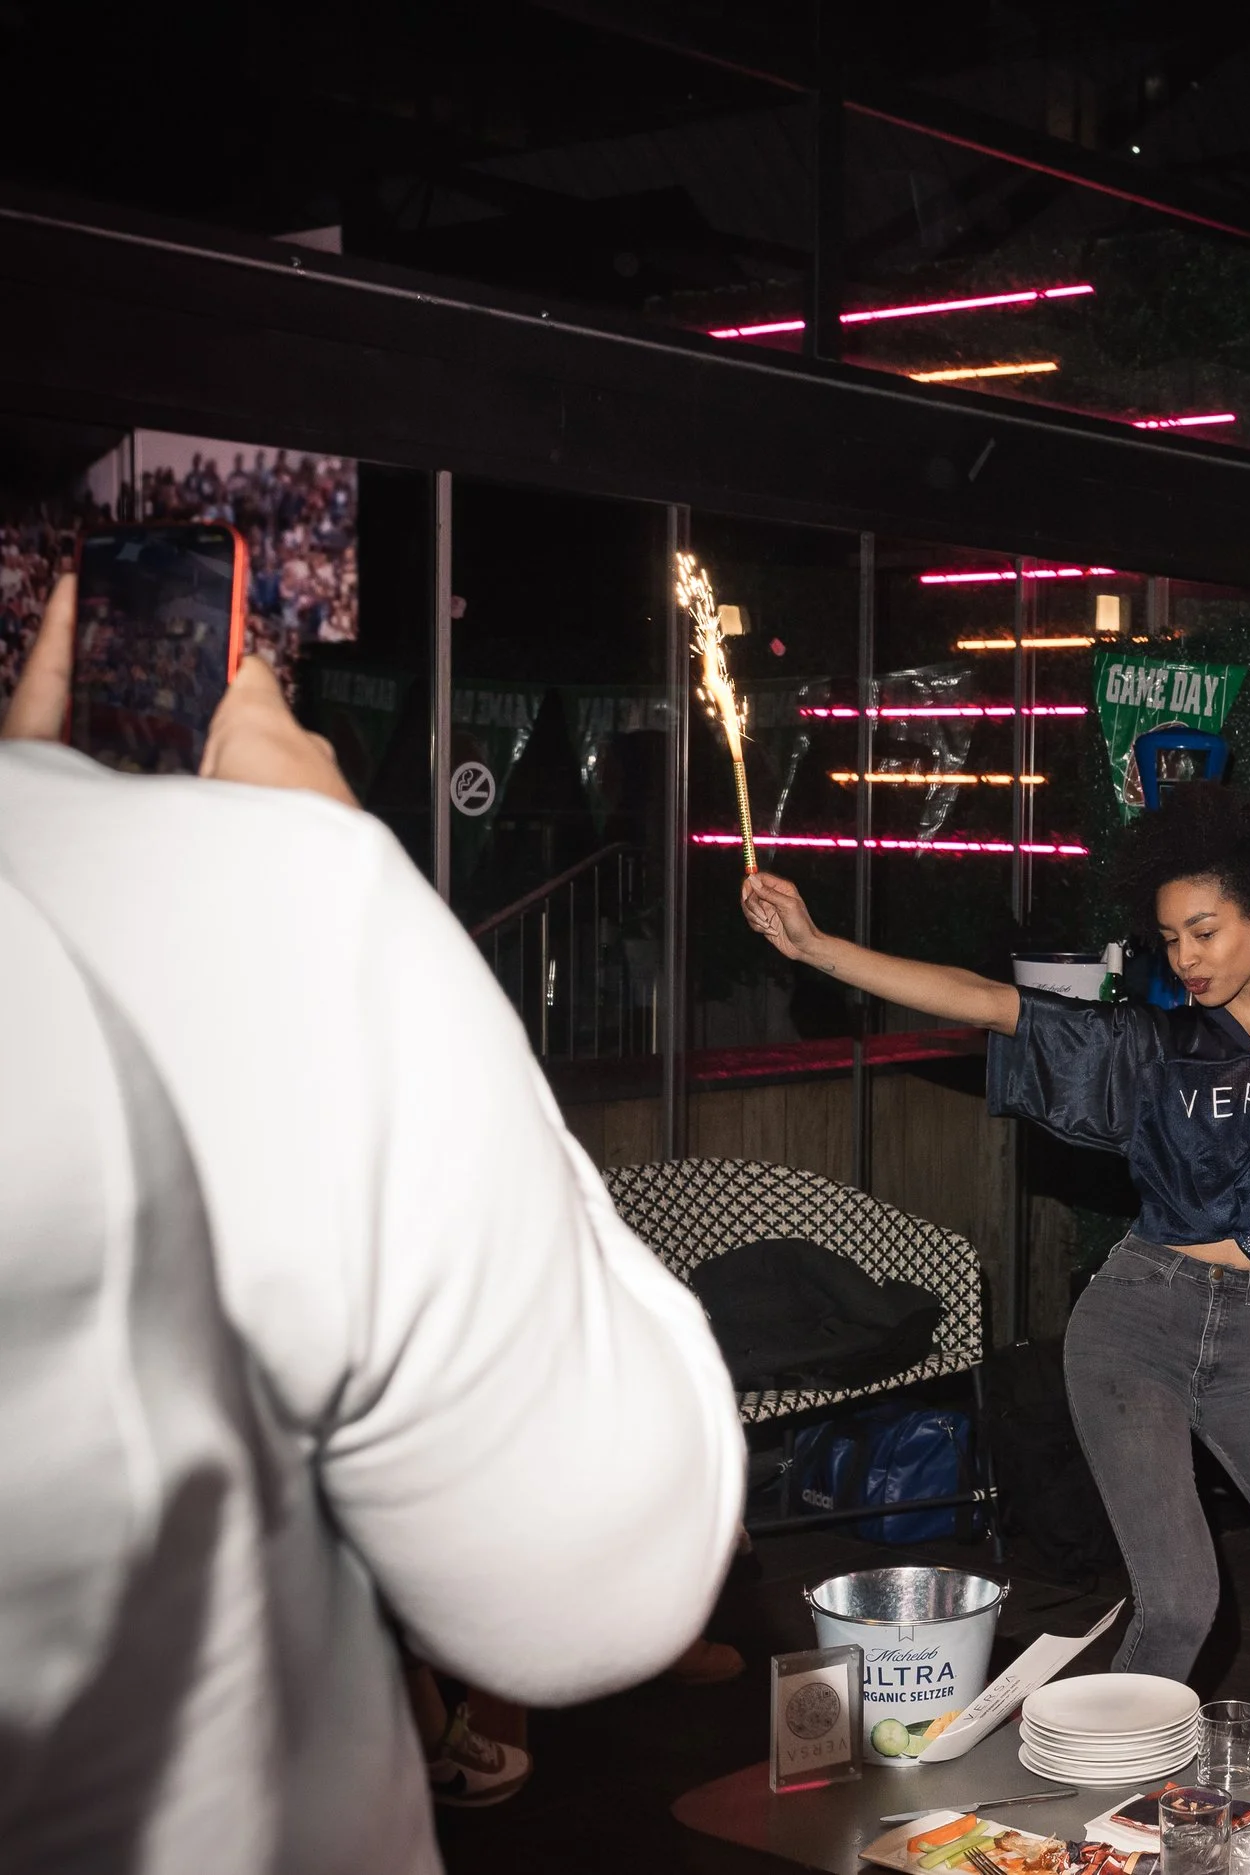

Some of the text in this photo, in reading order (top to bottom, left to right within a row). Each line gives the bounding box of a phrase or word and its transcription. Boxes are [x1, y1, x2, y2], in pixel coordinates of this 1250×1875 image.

[1106, 664, 1219, 717] GAME DAY
[866, 1645, 941, 1663] Michelob
[864, 1686, 955, 1703] RGANIC SELTZER
[963, 1675, 1016, 1721] VERSA
[787, 1737, 848, 1762] VERSA
